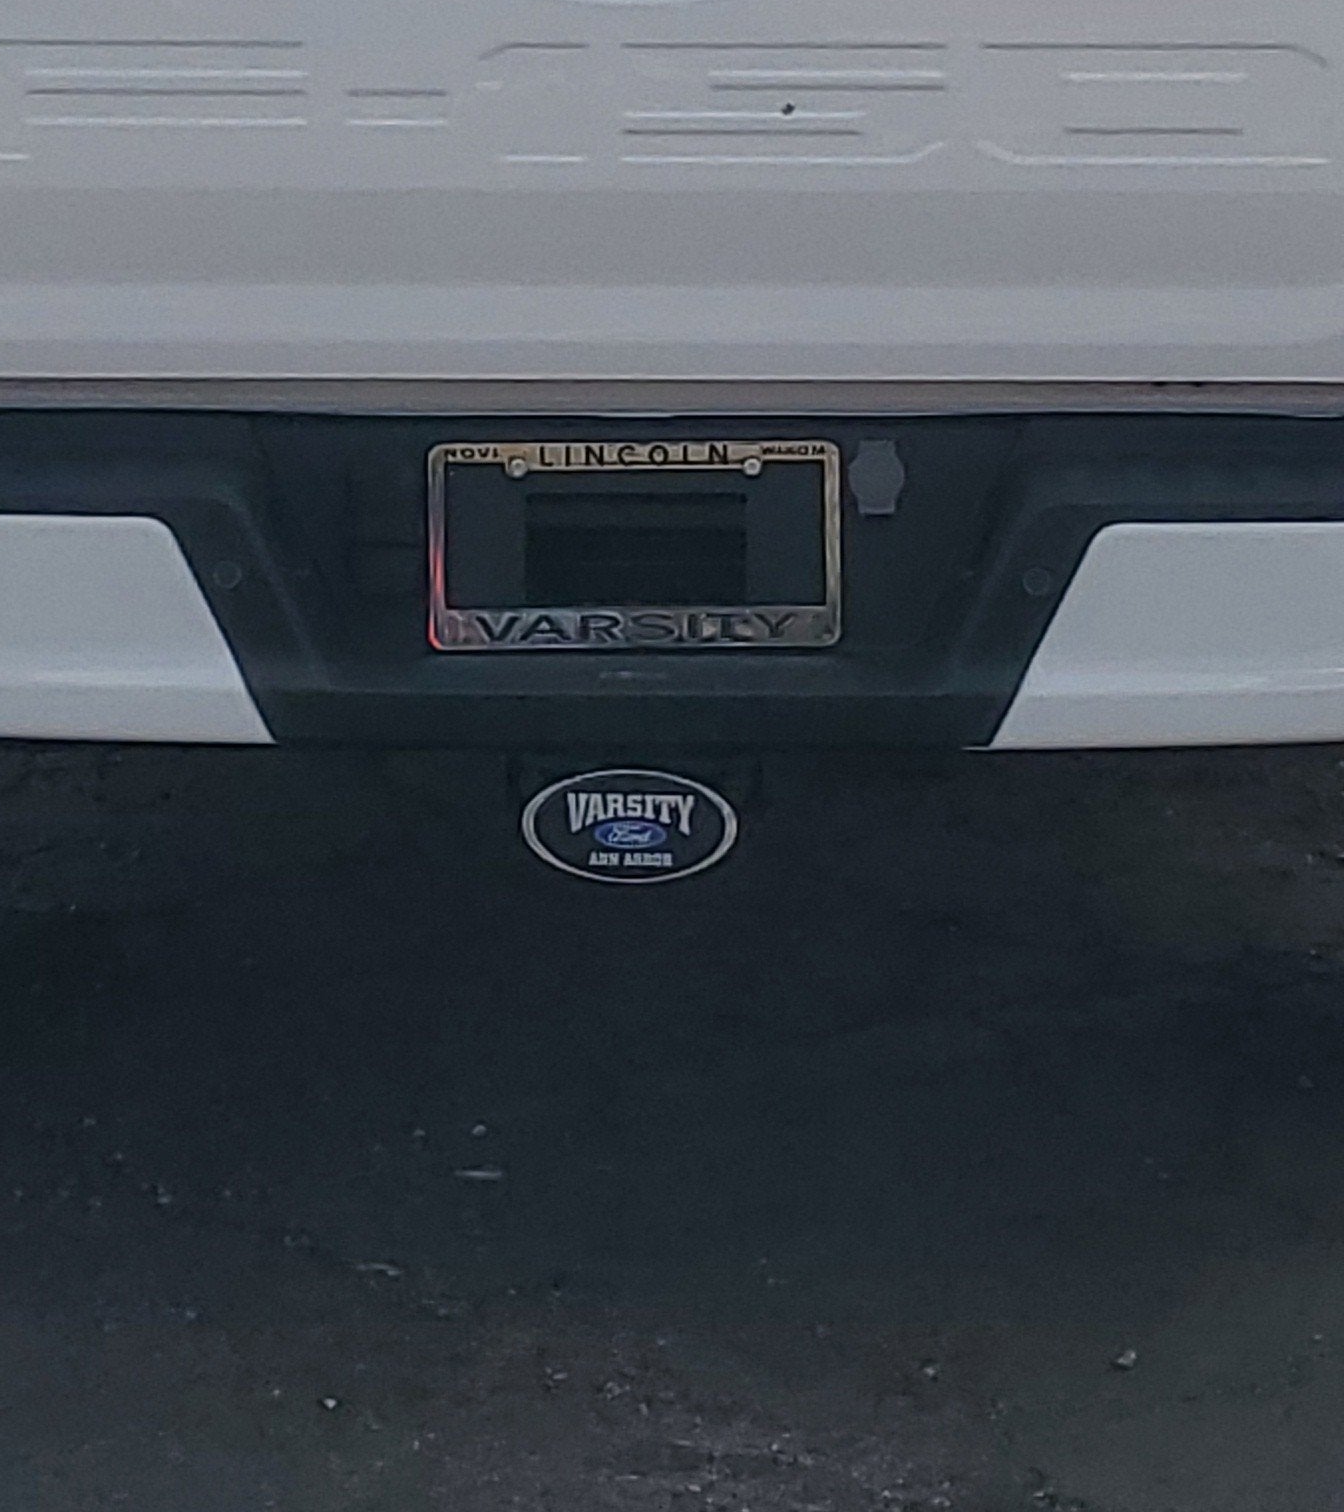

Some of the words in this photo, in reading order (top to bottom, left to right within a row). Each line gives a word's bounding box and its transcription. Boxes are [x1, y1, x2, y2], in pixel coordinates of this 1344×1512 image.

[444, 447, 499, 459] NOVI
[539, 444, 729, 467] LINCOLN
[475, 613, 796, 643] VARSITY
[566, 791, 695, 836] VARSITY
